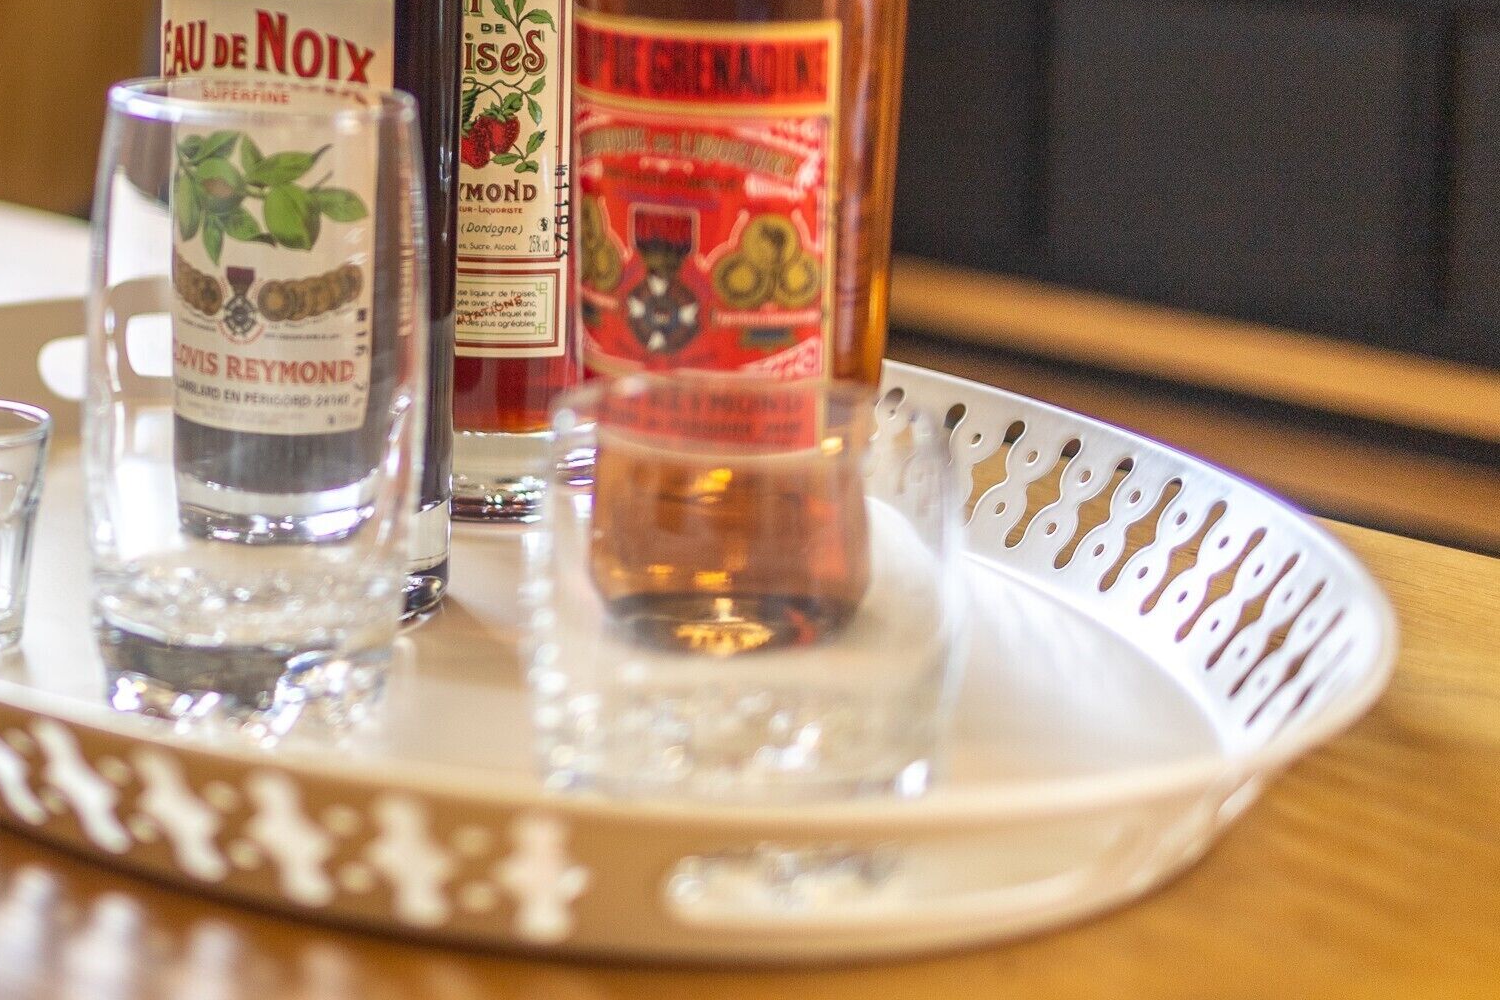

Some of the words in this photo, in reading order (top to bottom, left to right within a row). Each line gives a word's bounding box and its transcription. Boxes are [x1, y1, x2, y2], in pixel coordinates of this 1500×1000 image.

[480, 23, 506, 35] DE
[212, 32, 248, 69] DE
[254, 7, 376, 85] NOIX
[202, 87, 290, 105] SUPERFINE
[461, 222, 524, 238] (Dordogne)
[498, 289, 508, 298] de
[481, 320, 496, 329] plus
[225, 353, 356, 385] REYMOND
